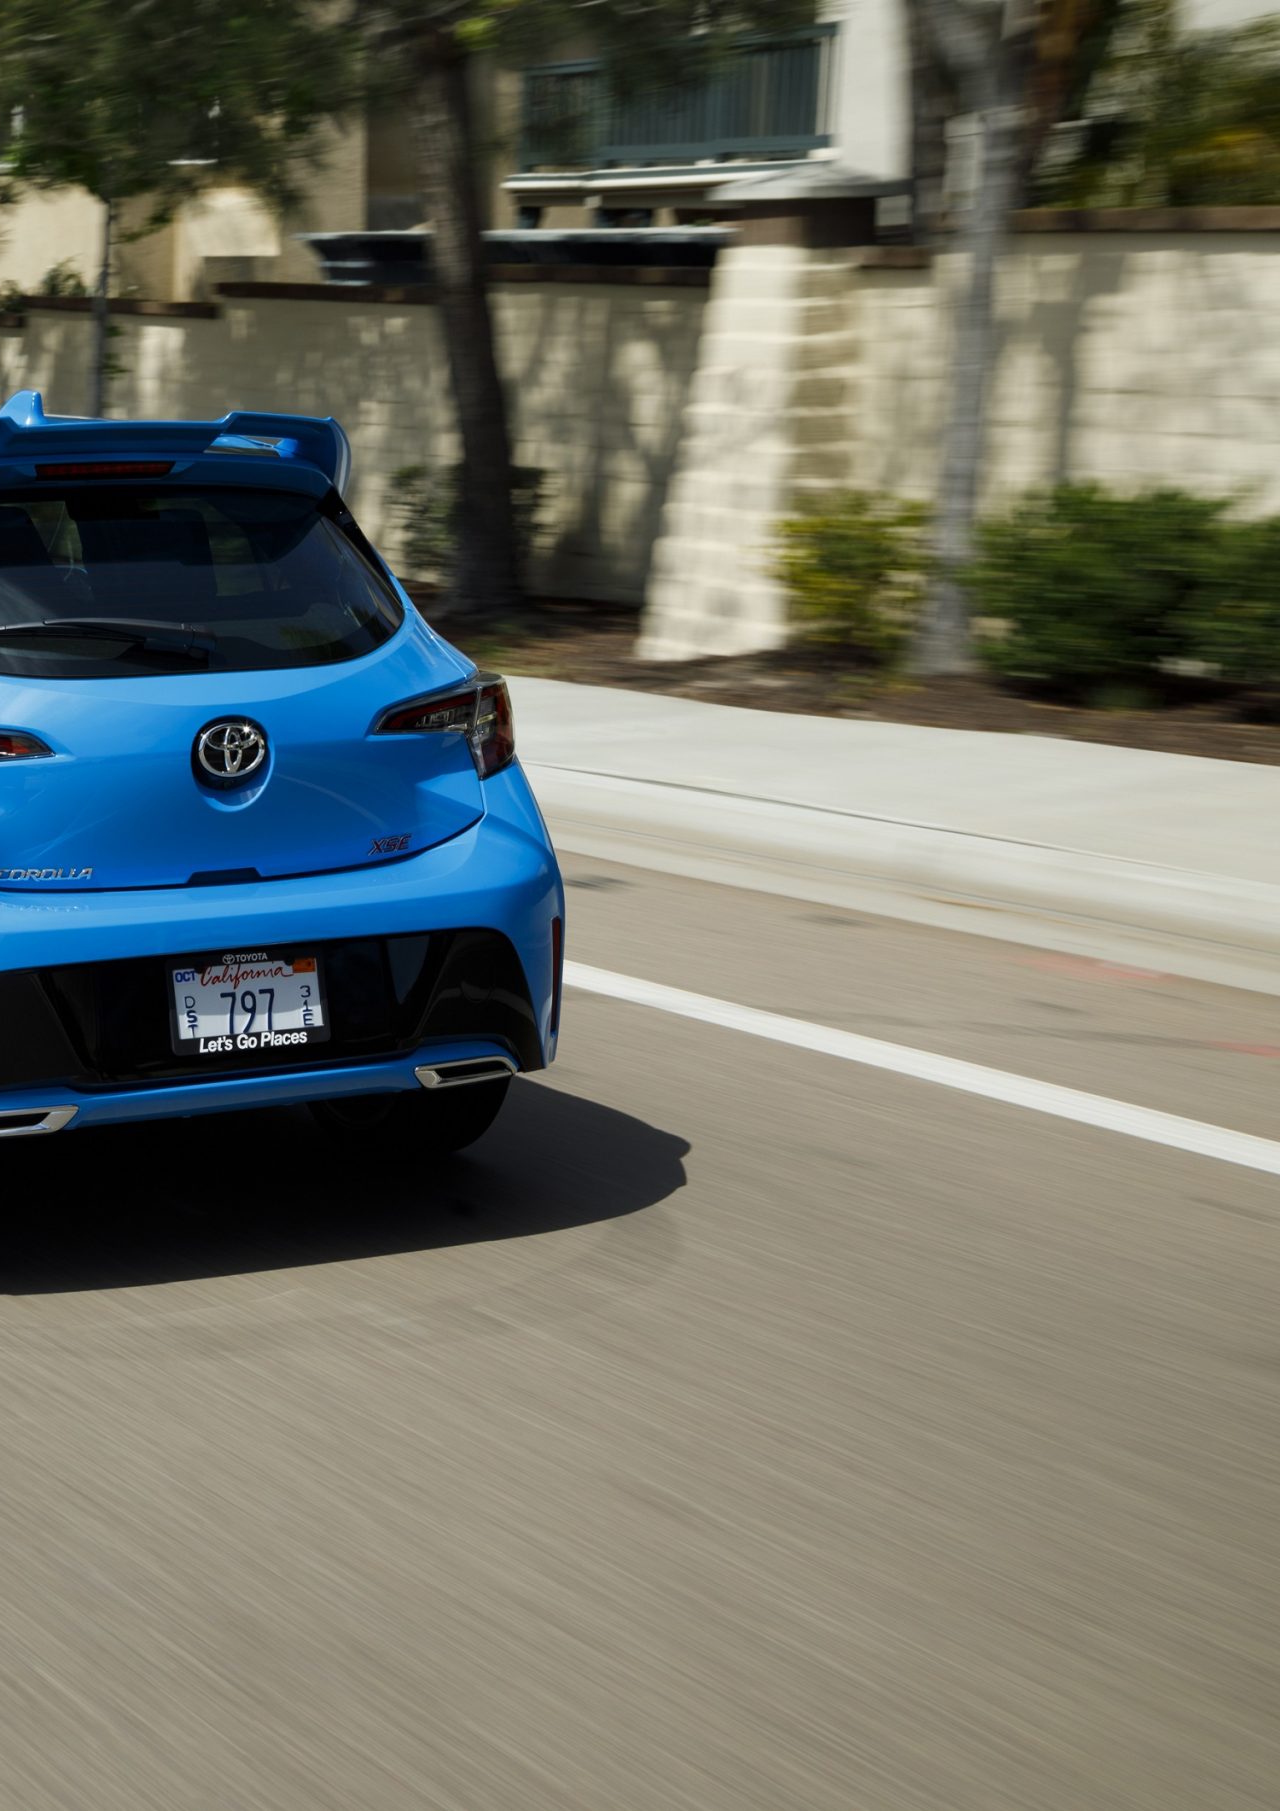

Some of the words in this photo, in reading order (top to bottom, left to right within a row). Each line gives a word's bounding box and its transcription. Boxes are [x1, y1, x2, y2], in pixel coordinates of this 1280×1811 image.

[368, 834, 412, 856] XSE
[235, 952, 268, 963] TOYOTA
[175, 970, 197, 983] OCT
[200, 963, 294, 989] California
[220, 988, 275, 1034] 797
[199, 1036, 233, 1053] Let's
[236, 1034, 258, 1050] Go
[260, 1031, 308, 1047] Places
